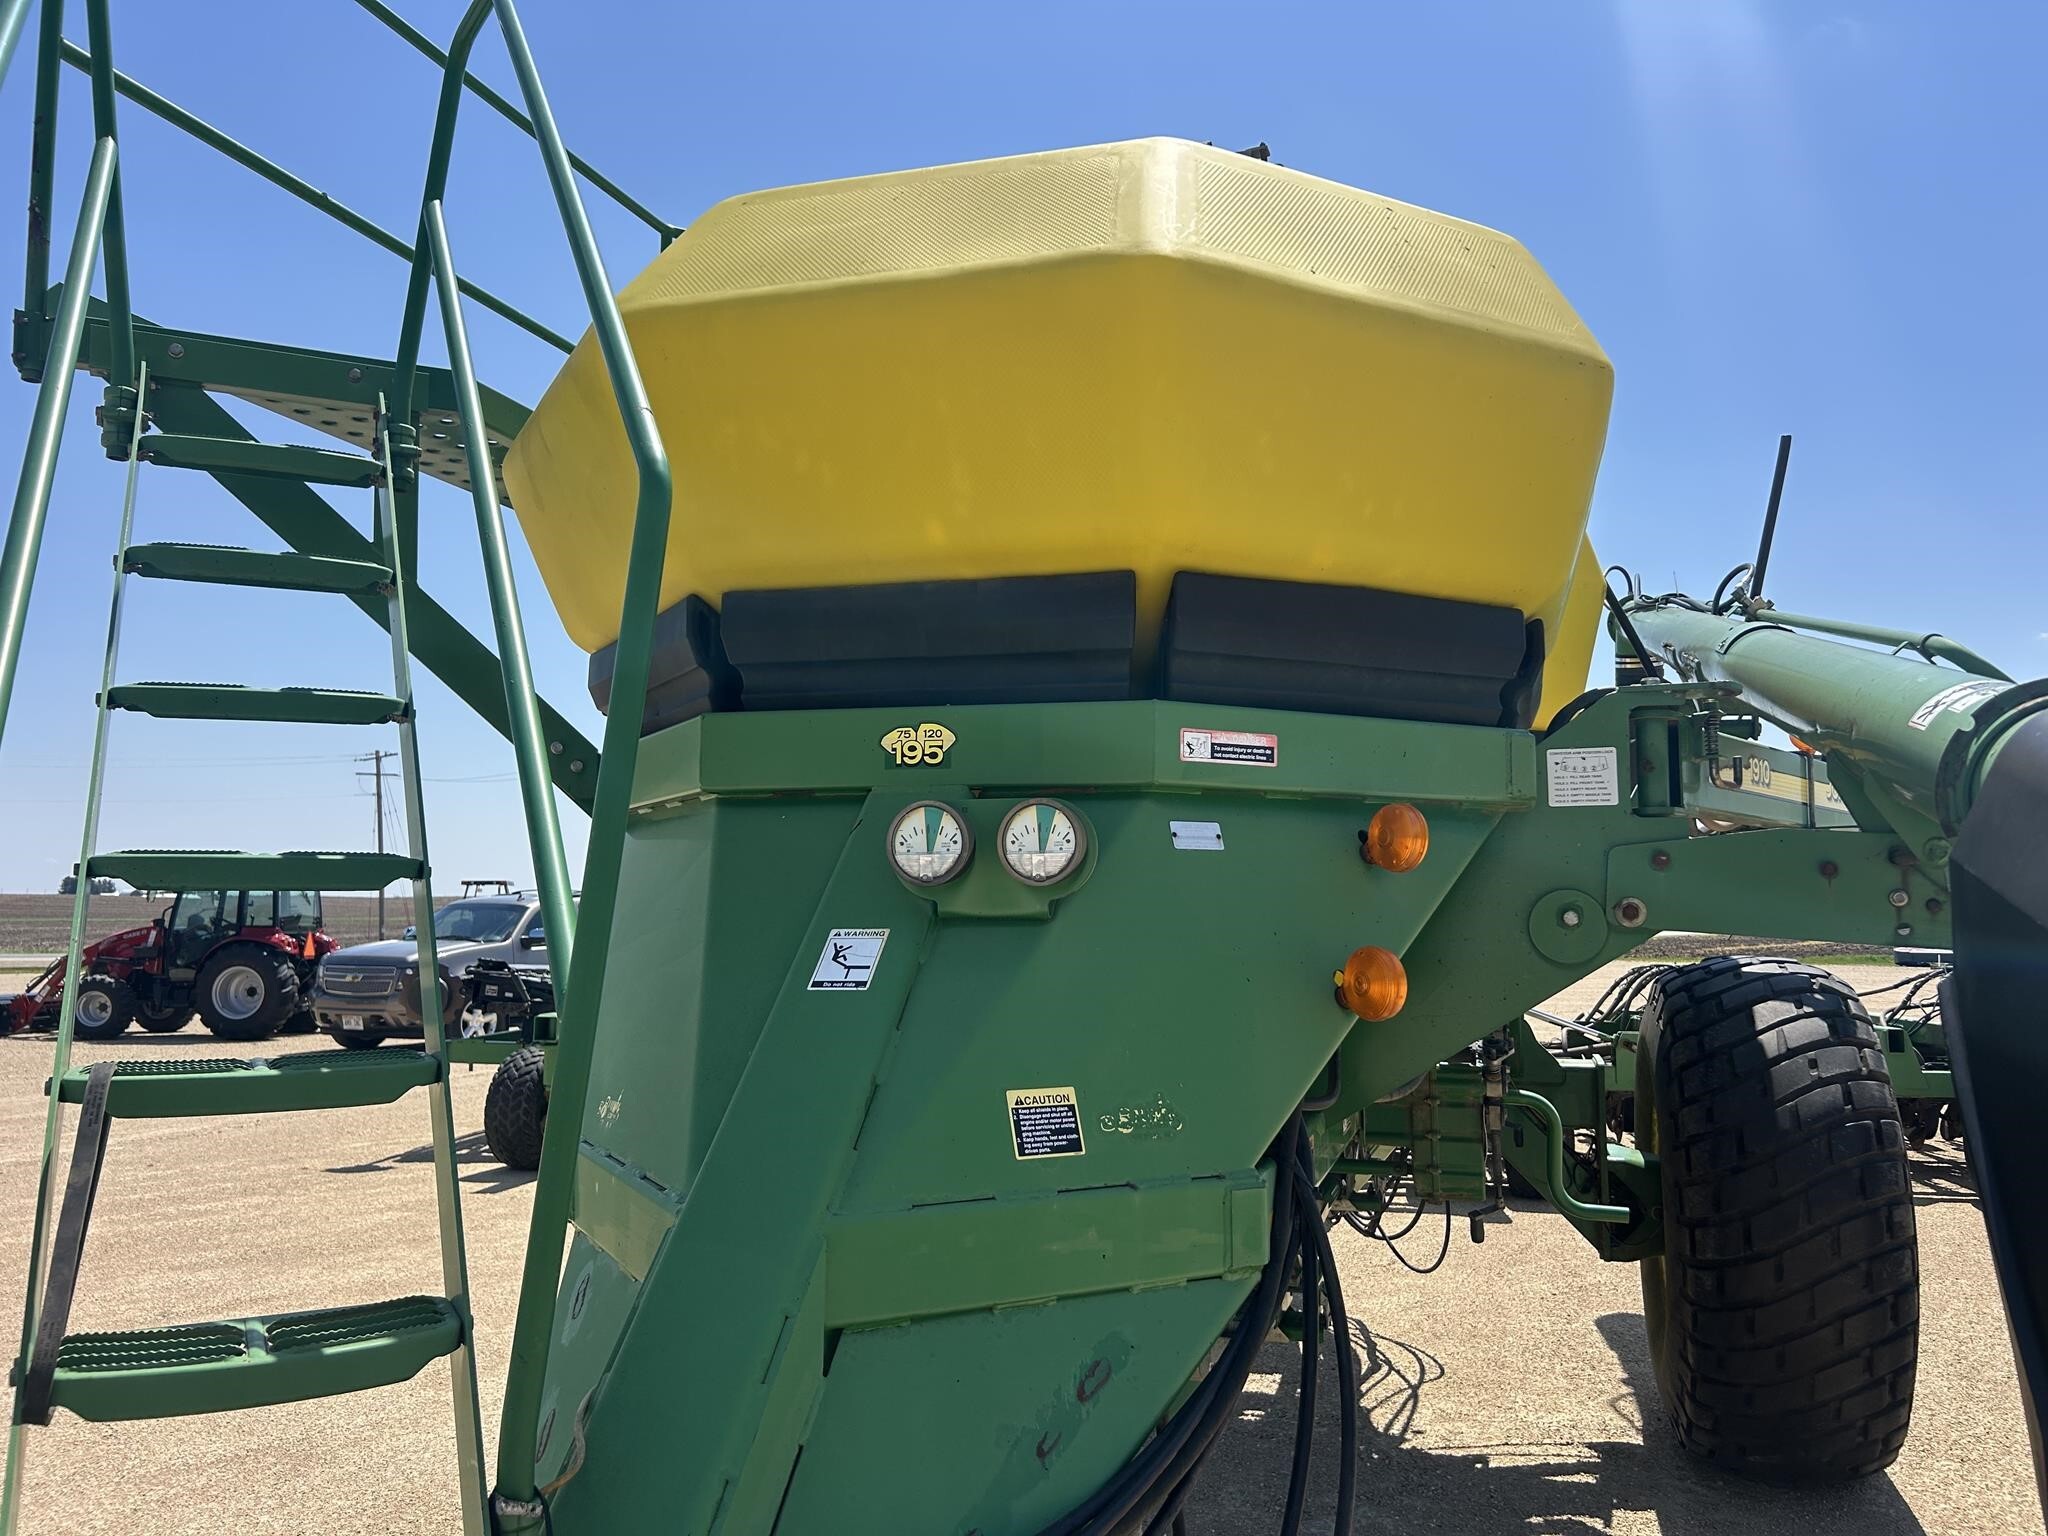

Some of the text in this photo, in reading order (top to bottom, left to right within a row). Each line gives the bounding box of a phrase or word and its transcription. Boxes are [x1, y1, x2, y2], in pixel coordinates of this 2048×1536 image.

[897, 729, 942, 738] 75 120
[891, 740, 944, 766] 195
[1749, 758, 1770, 787] 1910
[1024, 1094, 1070, 1105] CAUTION
